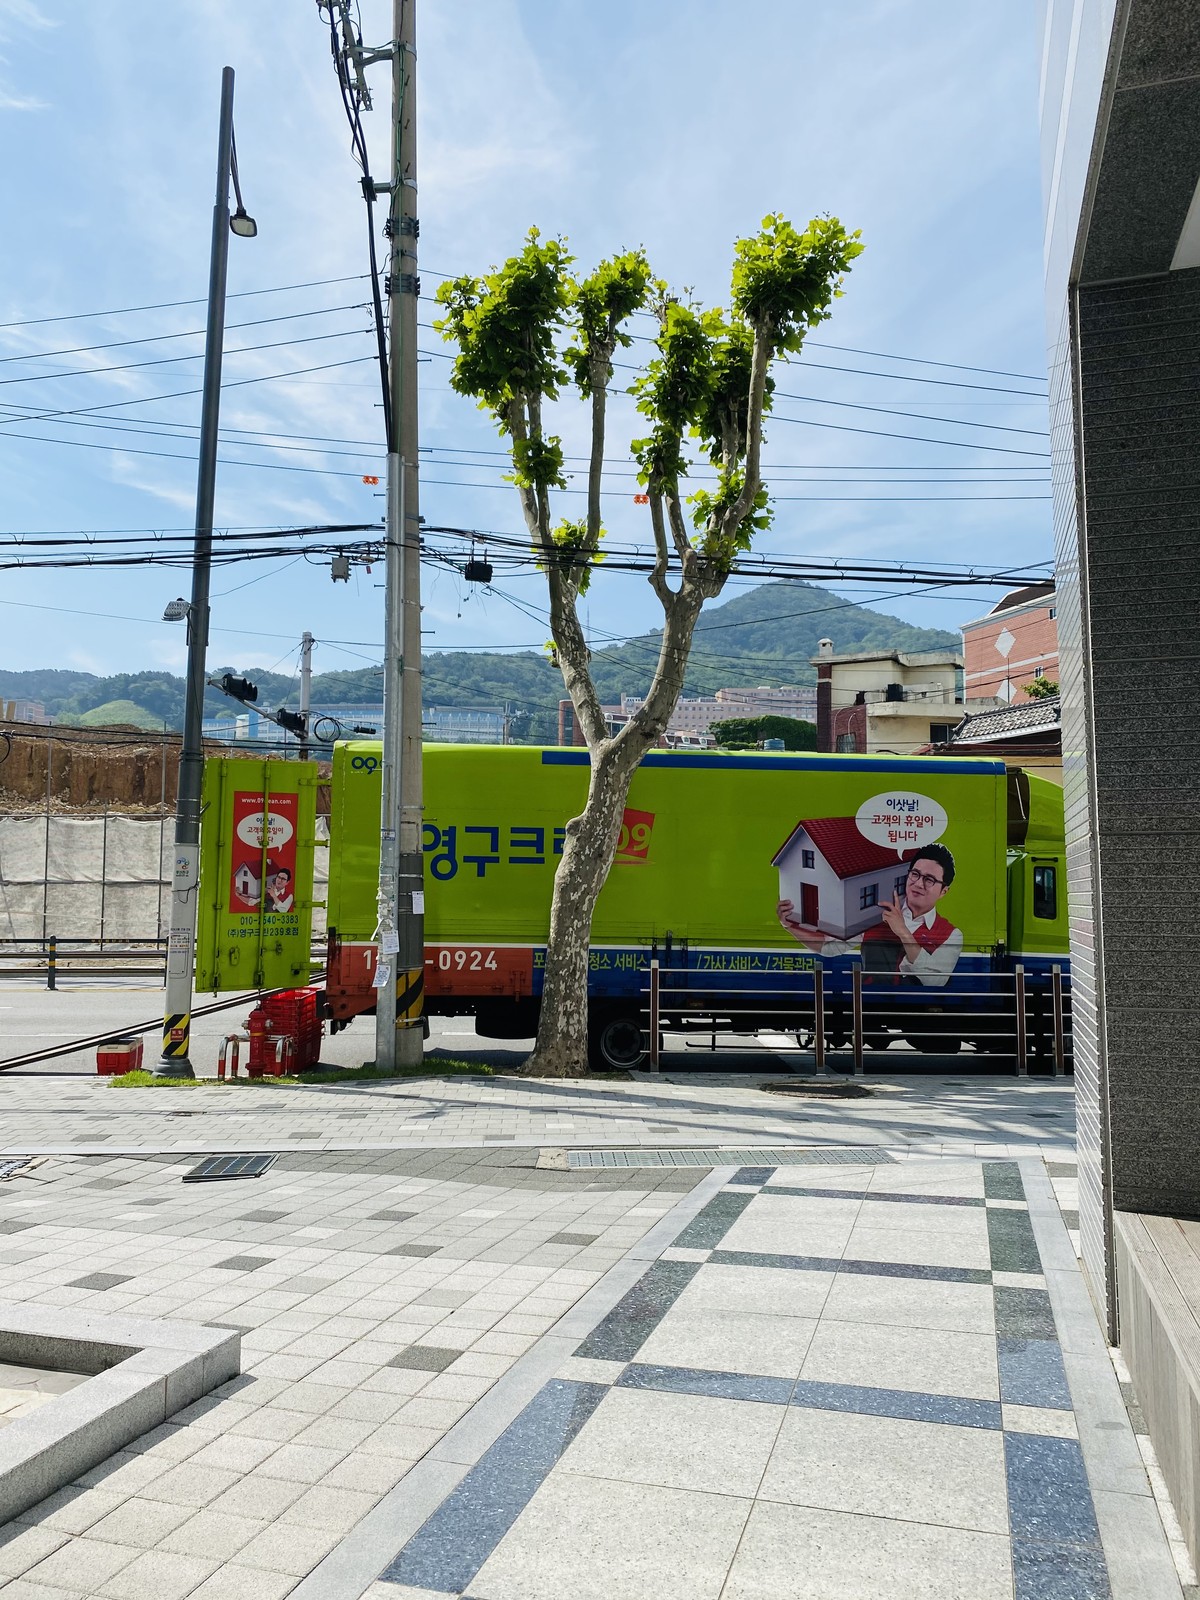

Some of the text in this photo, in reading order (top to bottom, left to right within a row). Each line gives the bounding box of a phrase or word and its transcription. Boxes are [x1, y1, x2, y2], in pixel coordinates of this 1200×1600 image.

[886, 798, 919, 812] 이삿날!
[871, 814, 934, 828] 고객의 휴일이
[887, 830, 918, 843] 됩니다
[614, 952, 649, 971] 서비스
